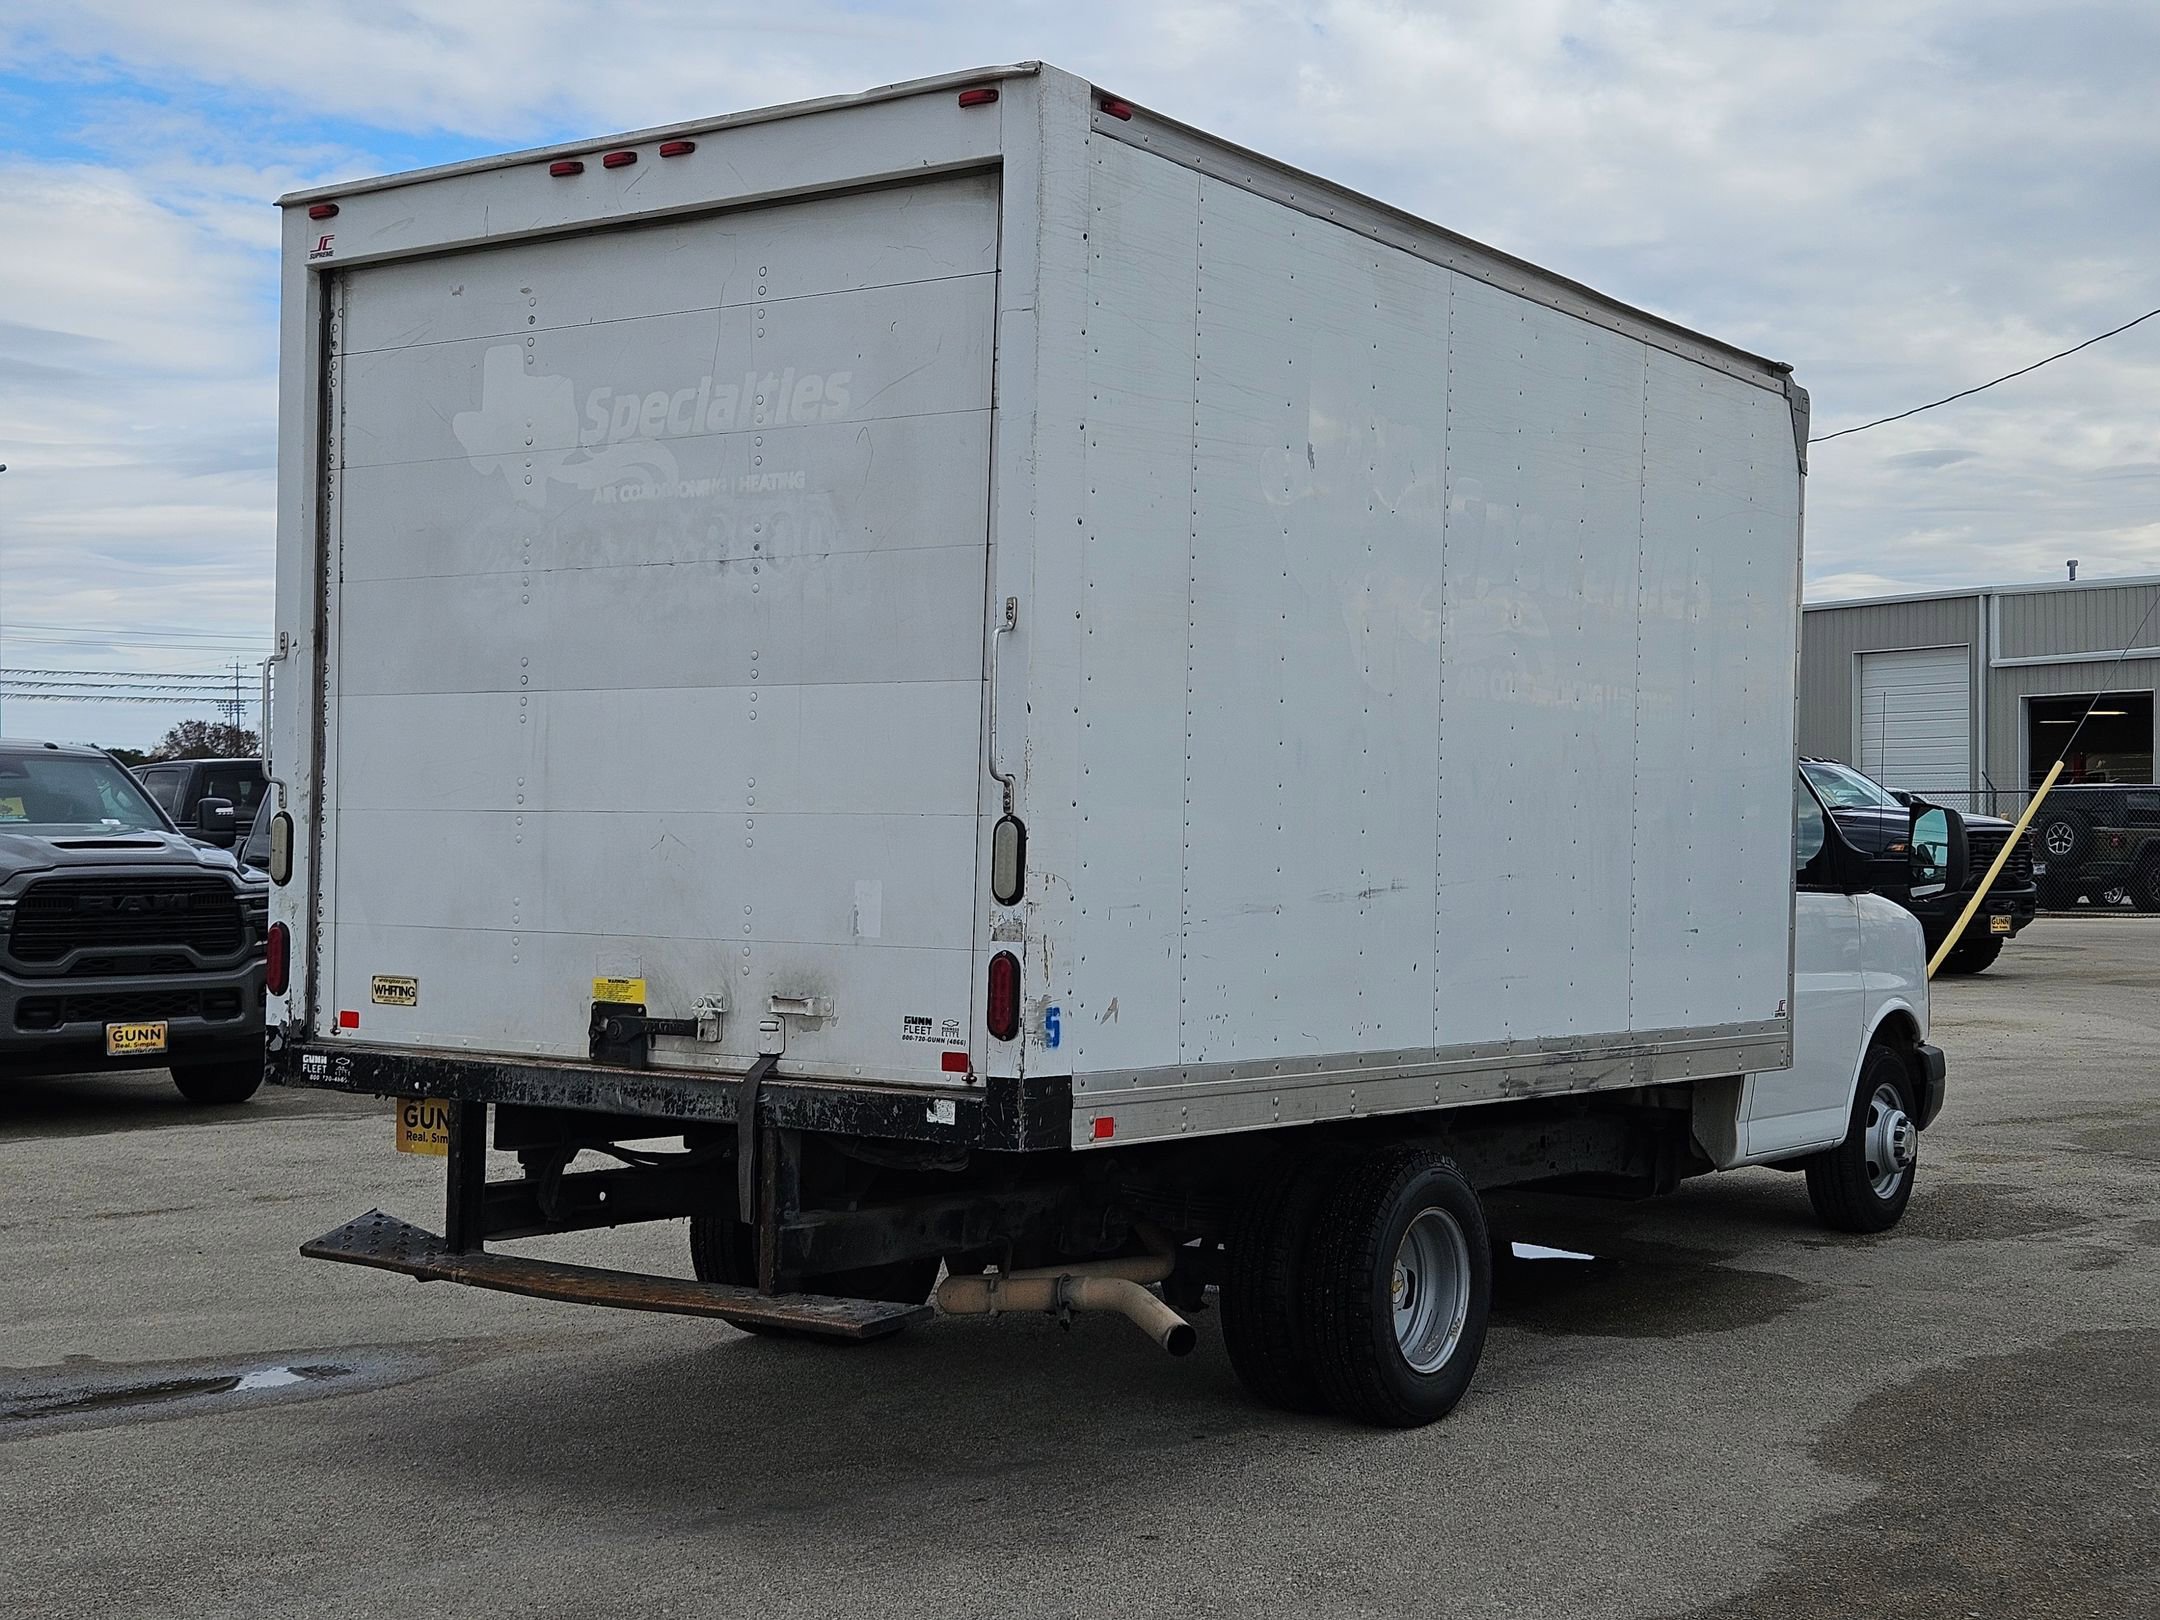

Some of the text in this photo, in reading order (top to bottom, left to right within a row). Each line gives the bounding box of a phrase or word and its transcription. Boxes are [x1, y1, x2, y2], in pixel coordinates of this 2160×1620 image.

[739, 471, 806, 494] HEATING
[373, 984, 416, 997] WHITING
[904, 1016, 933, 1026] GUNN
[112, 1029, 162, 1042] GUNN
[903, 1025, 932, 1035] FLEET
[302, 1054, 328, 1065] GUNN
[302, 1063, 328, 1074] FLEET
[406, 1131, 429, 1143] Real.
